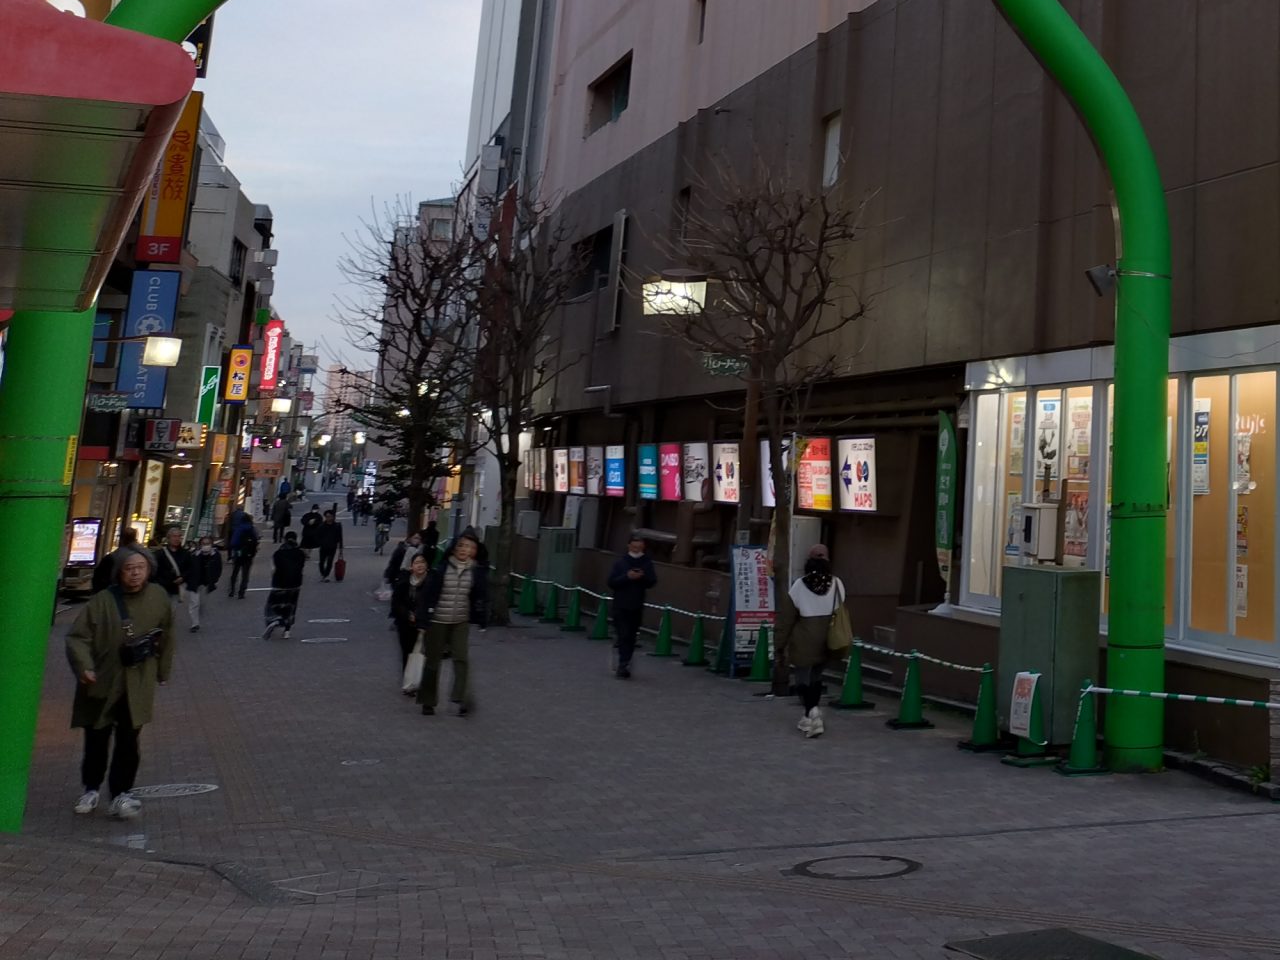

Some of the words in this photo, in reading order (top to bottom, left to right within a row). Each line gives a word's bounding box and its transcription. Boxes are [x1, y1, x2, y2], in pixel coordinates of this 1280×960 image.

[147, 243, 170, 255] 3F
[145, 276, 161, 311] CLUB
[231, 371, 246, 395] 松屋
[148, 442, 170, 450] KFC
